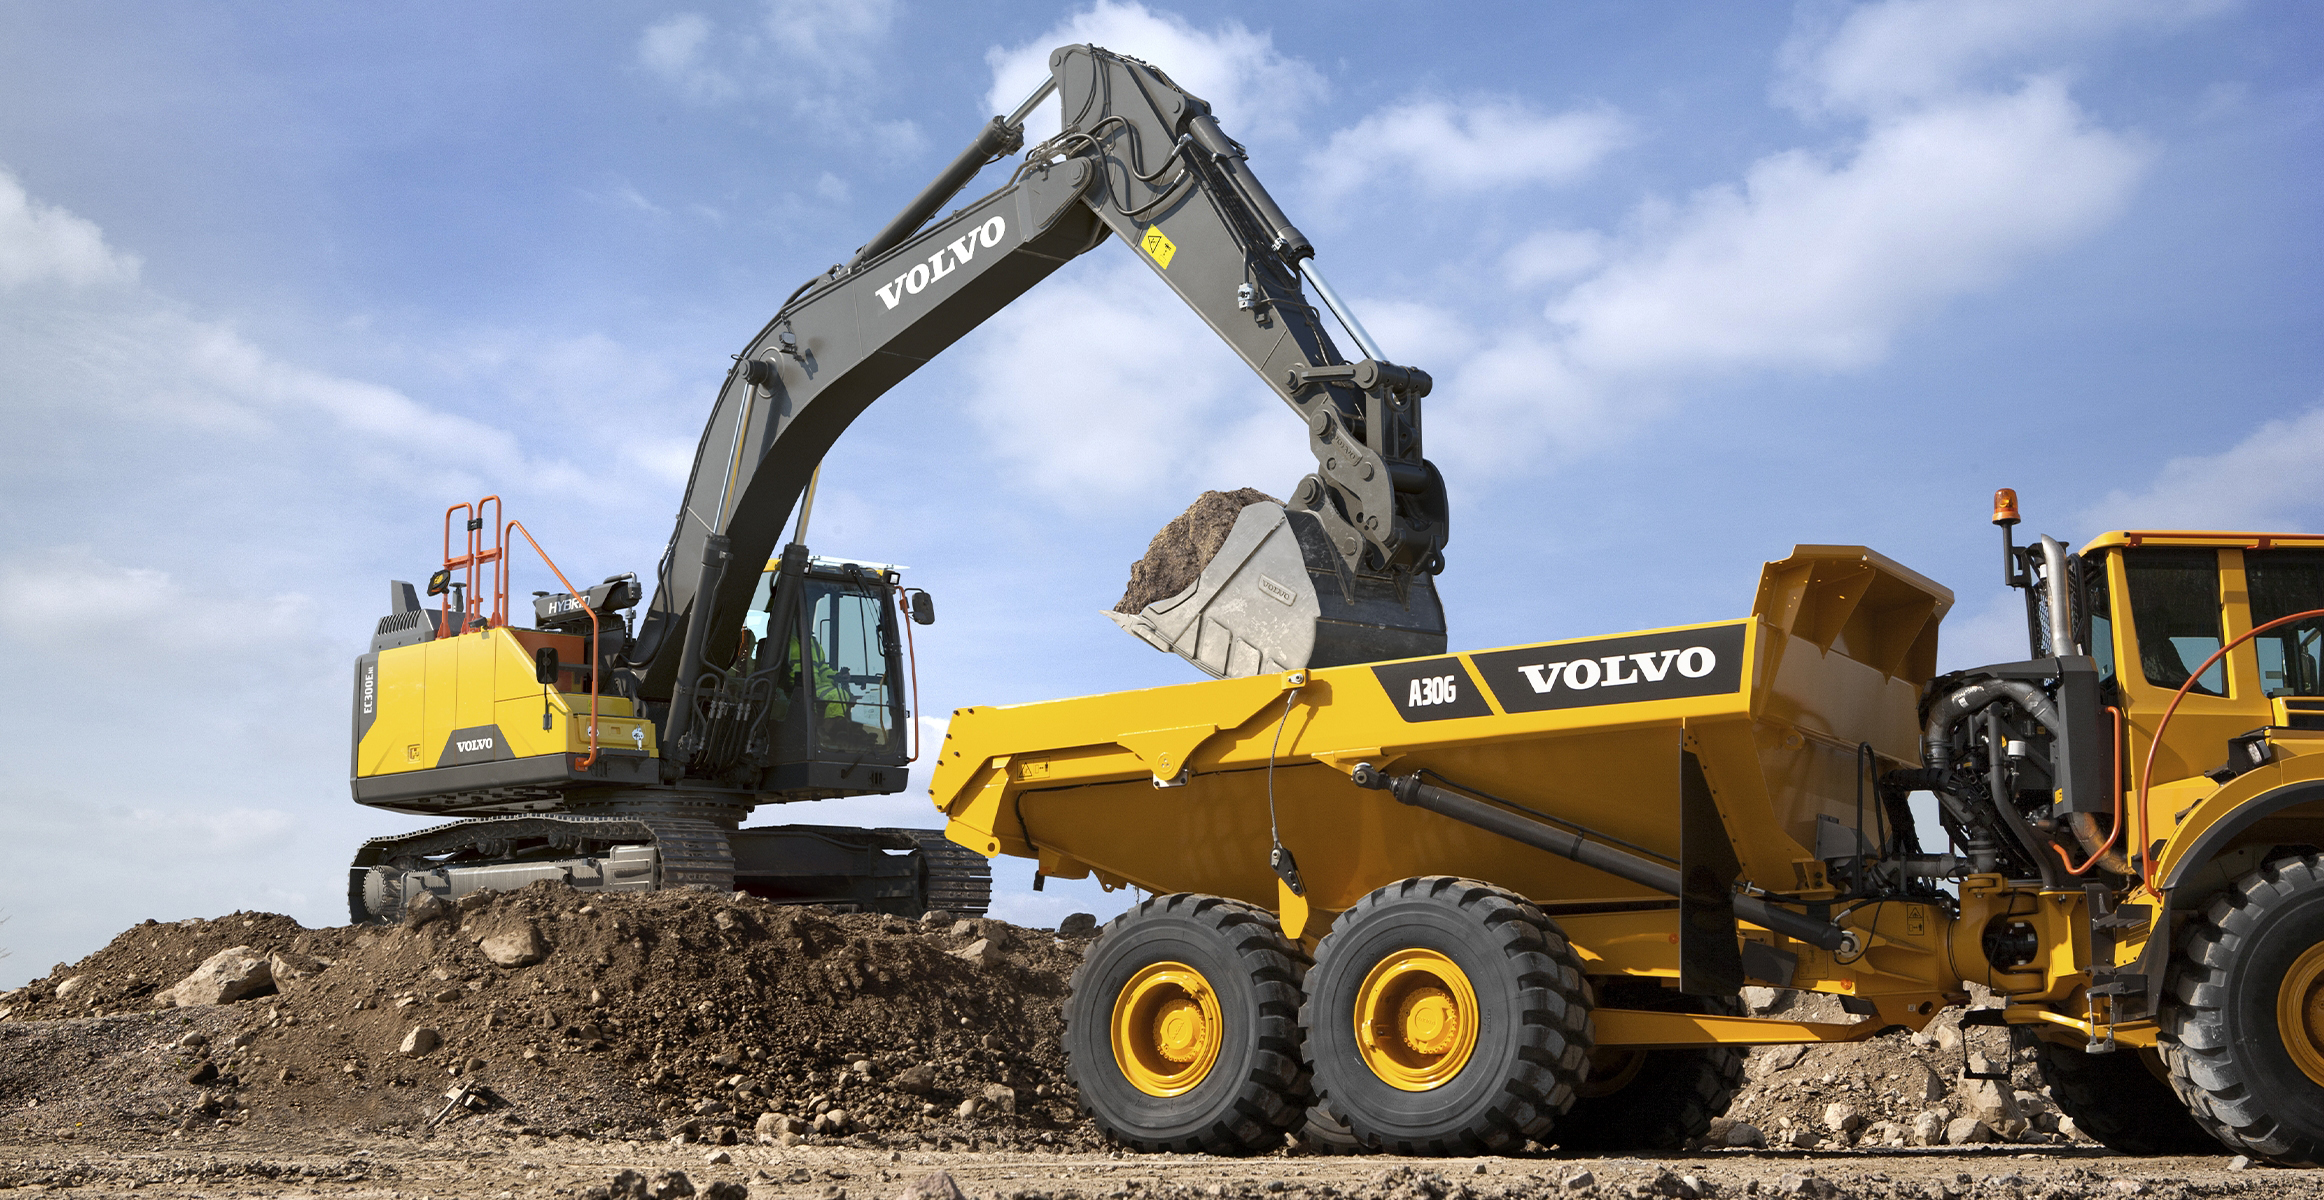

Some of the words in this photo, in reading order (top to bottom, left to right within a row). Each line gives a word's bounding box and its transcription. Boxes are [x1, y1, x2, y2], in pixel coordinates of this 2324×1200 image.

[875, 216, 1005, 310] VOLVO
[1262, 579, 1290, 600] VOLVO
[1518, 646, 1716, 694] VOLVO
[1408, 675, 1457, 708] A30G
[456, 737, 493, 753] VOLVO
